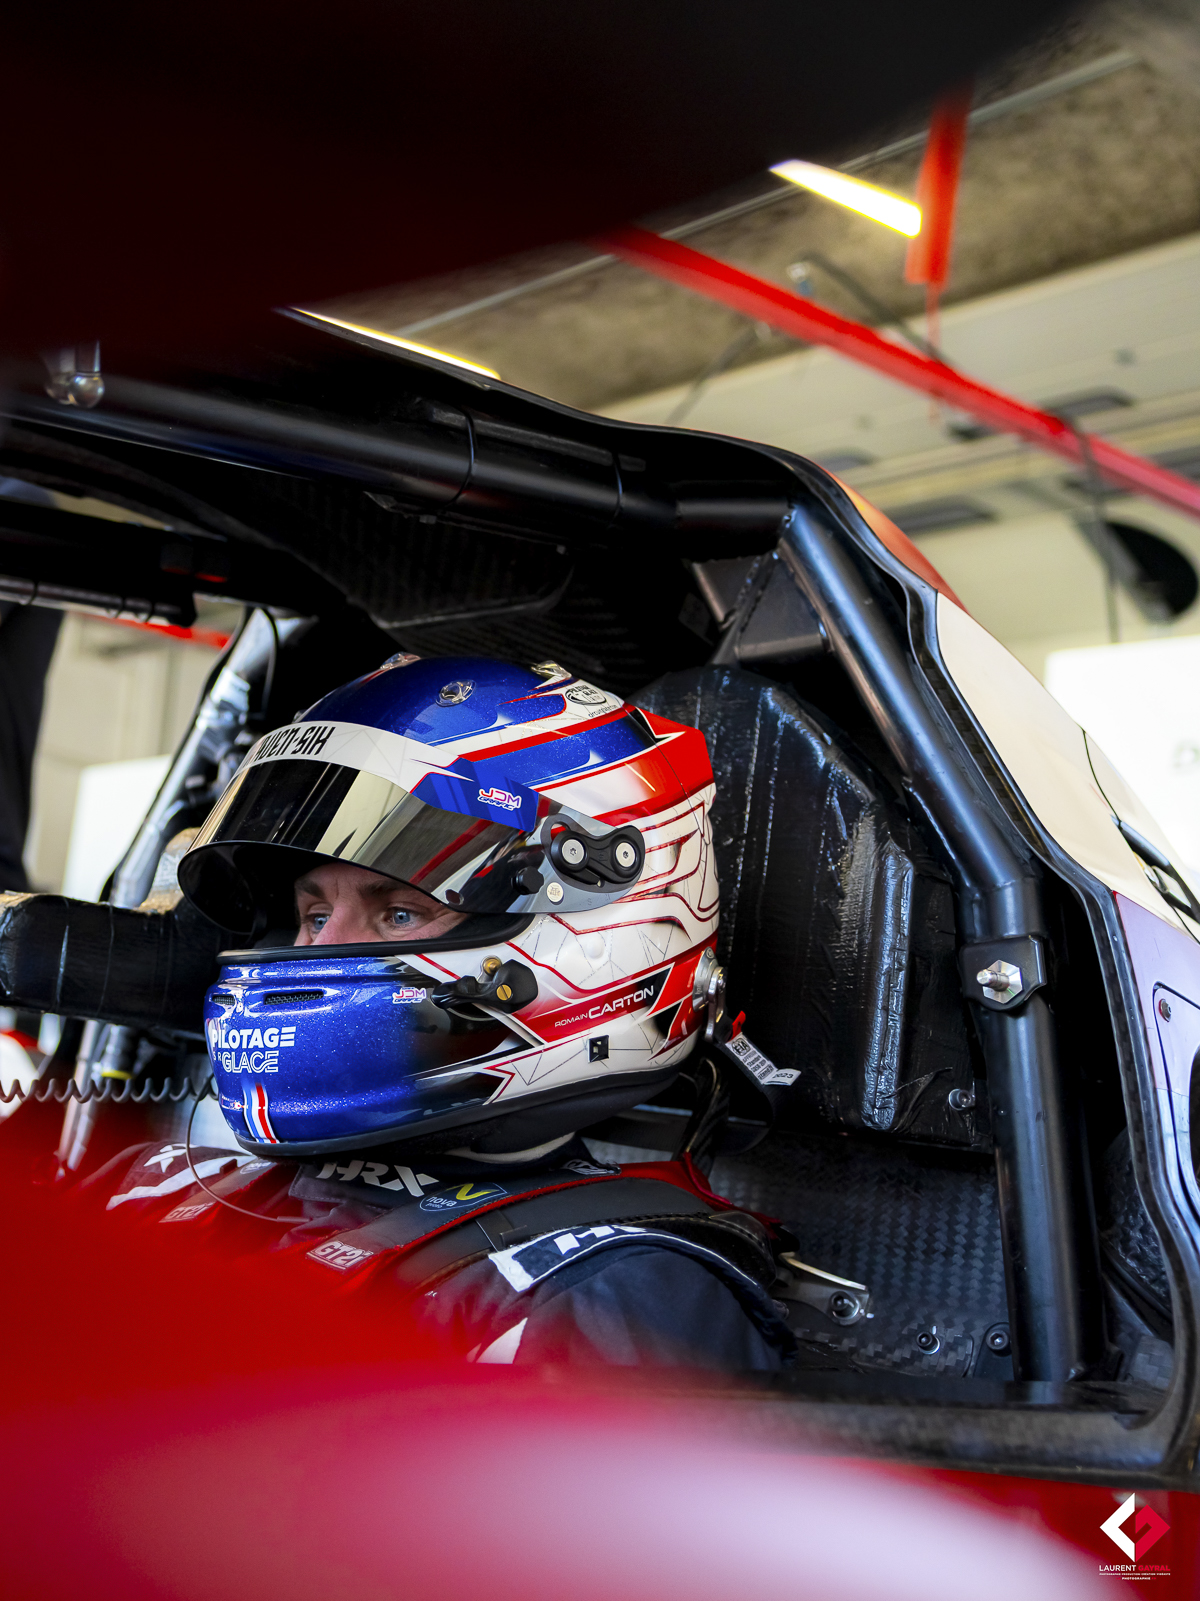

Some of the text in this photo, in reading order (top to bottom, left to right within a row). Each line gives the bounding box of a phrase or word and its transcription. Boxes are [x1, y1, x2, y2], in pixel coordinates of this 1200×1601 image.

[480, 789, 520, 807] JDM
[394, 989, 426, 999] JDM
[554, 985, 654, 1028] ROMAIN CARTON
[212, 1026, 297, 1050] PILOTAGE
[222, 1050, 280, 1074] GLACE
[316, 1159, 440, 1197] HRX
[426, 1196, 458, 1207] nova
